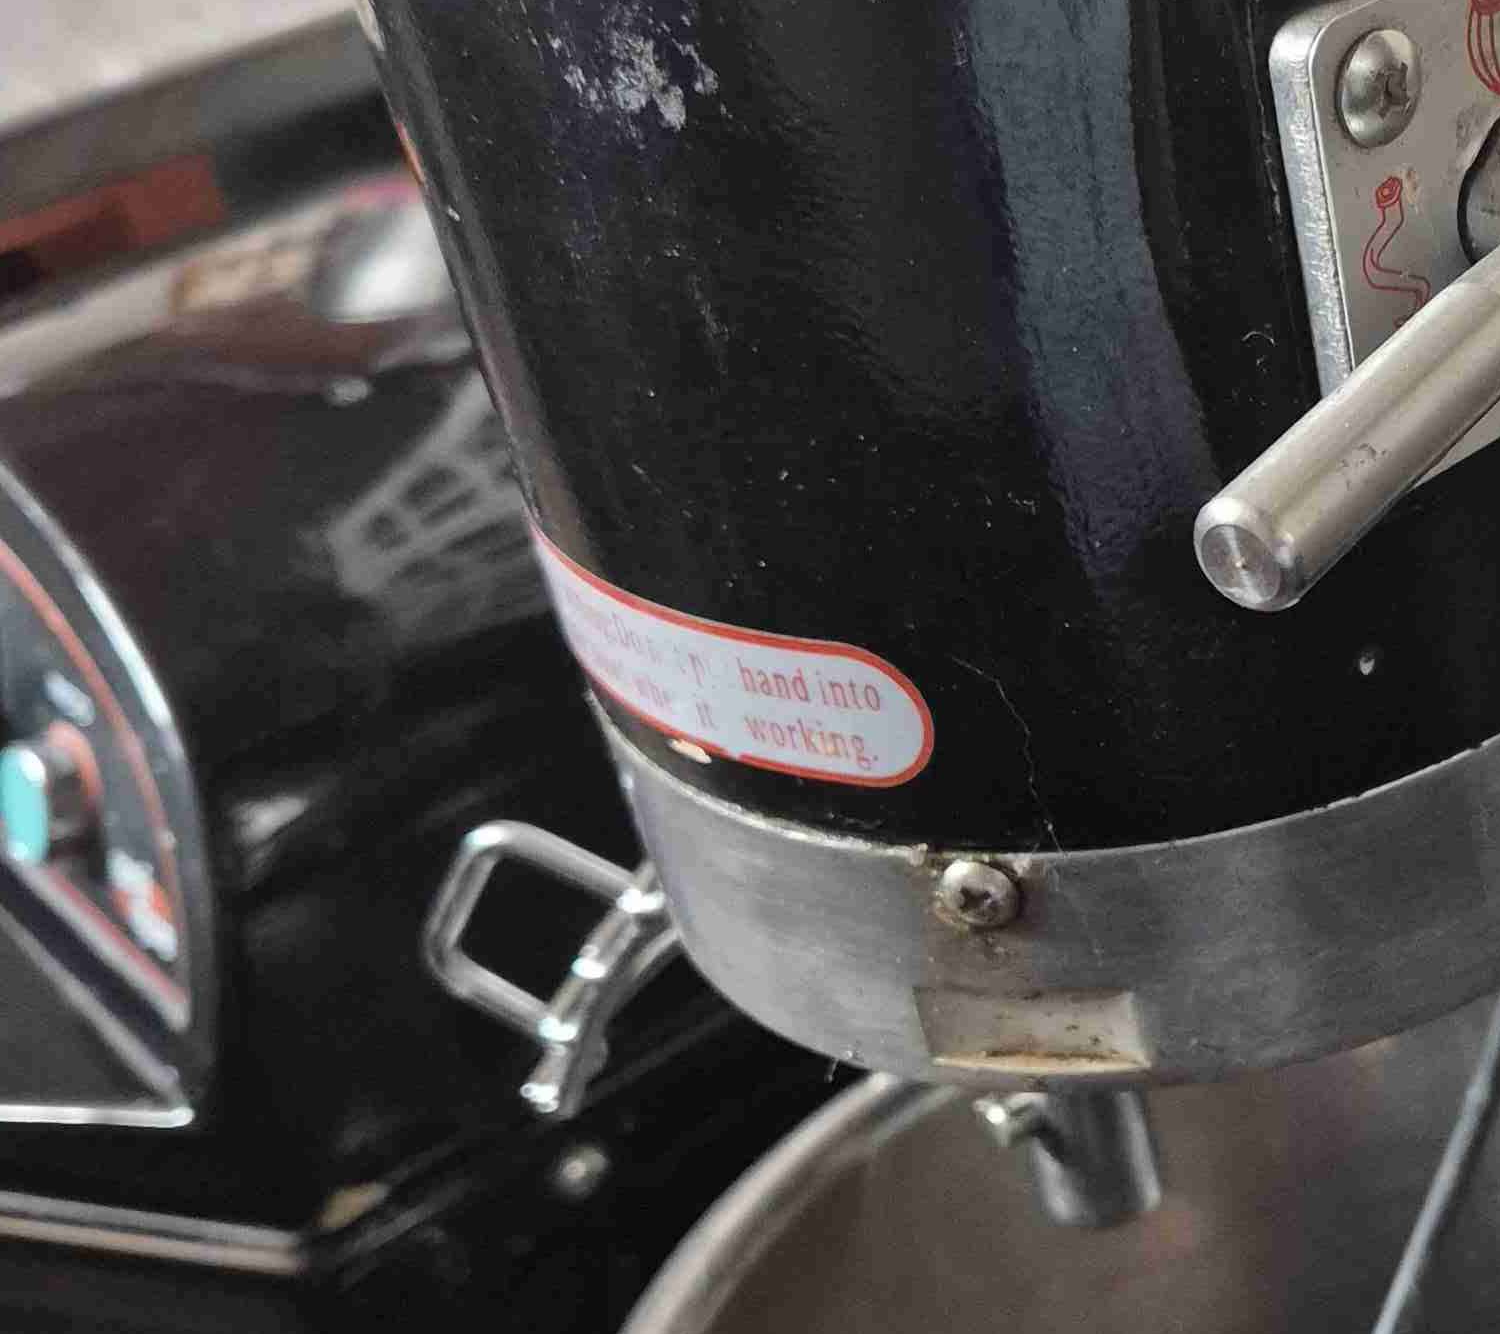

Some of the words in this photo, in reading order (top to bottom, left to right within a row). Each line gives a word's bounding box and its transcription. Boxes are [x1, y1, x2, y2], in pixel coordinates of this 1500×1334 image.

[736, 657, 811, 703] hand
[815, 669, 881, 712] into
[744, 714, 879, 770] working.
